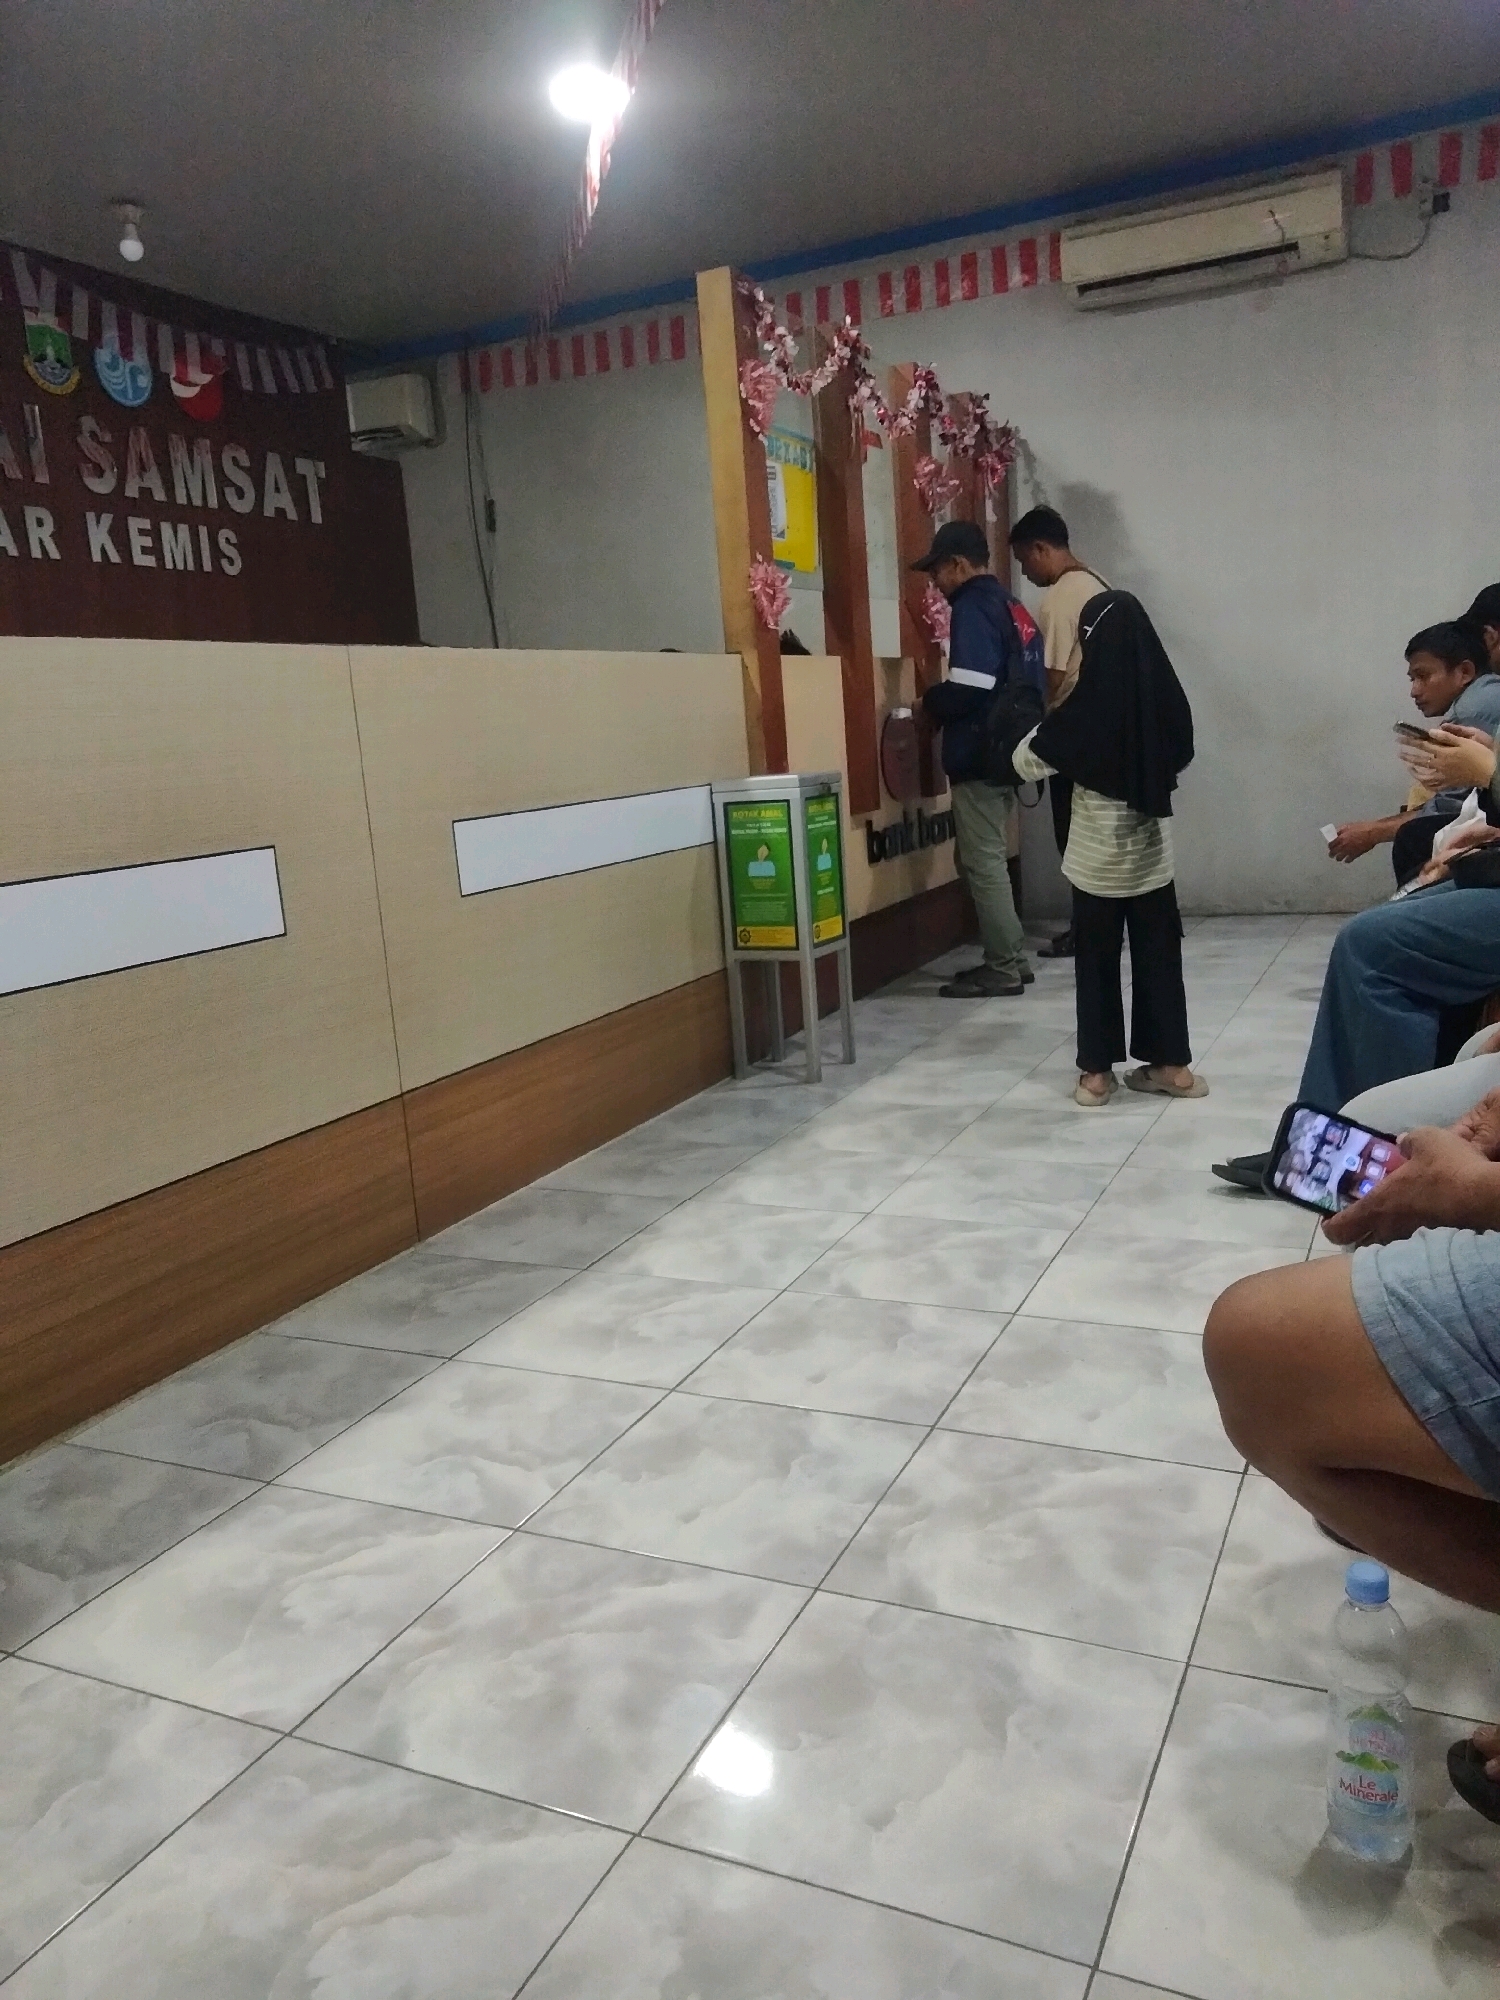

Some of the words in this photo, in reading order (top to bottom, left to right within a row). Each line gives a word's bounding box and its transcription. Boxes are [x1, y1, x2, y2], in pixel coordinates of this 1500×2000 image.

[77, 416, 325, 524] SAMSAT
[85, 511, 242, 576] KEMIS
[1339, 1777, 1399, 1802] Minerale
[1359, 1775, 1376, 1790] Le
